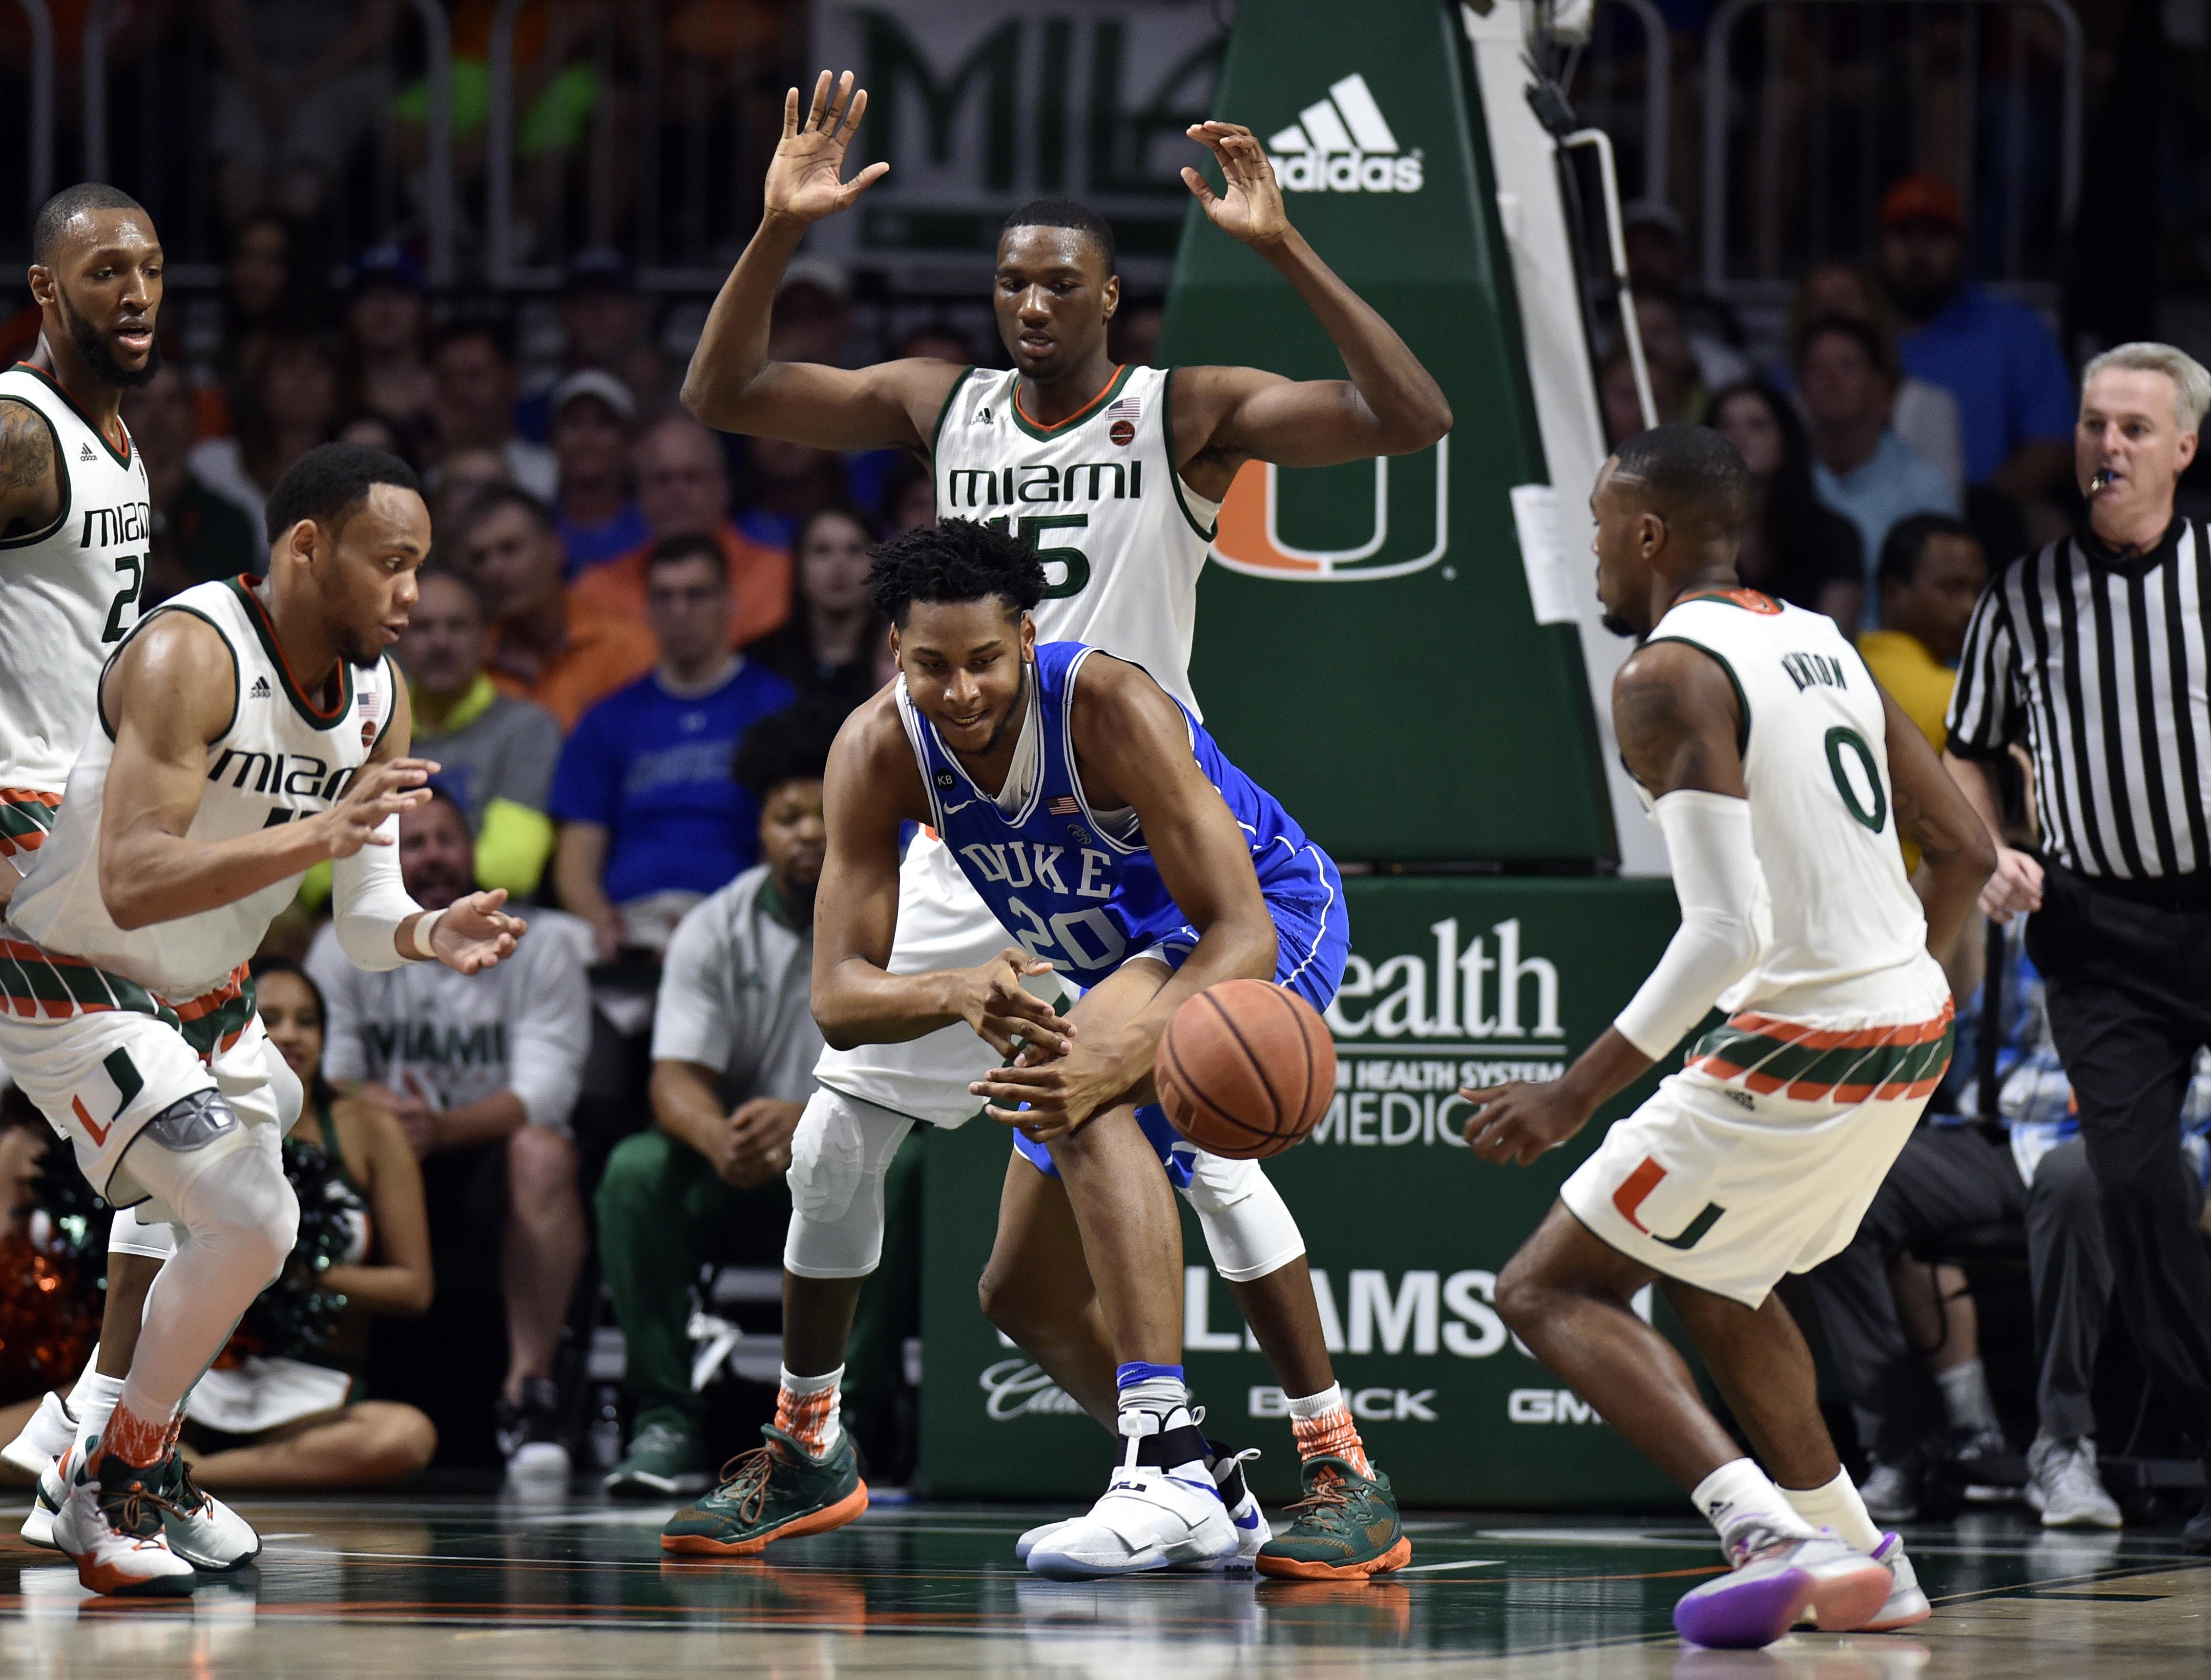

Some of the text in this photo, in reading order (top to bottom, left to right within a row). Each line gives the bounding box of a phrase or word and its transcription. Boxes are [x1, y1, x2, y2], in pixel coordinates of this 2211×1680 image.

[989, 514, 1090, 599] 5
[101, 552, 150, 643] 2
[937, 774, 953, 786] KB
[1824, 726, 1887, 833] 0
[958, 841, 1111, 898] DUKE
[1006, 896, 1127, 970] 20
[1323, 917, 1566, 1038] ealth
[1355, 1059, 1457, 1090] HEALTH
[1459, 1061, 1566, 1090] SYSTEM
[1311, 1091, 1478, 1147] MEDIC
[1248, 1385, 1437, 1422] BICK
[1508, 1388, 1604, 1424] GM
